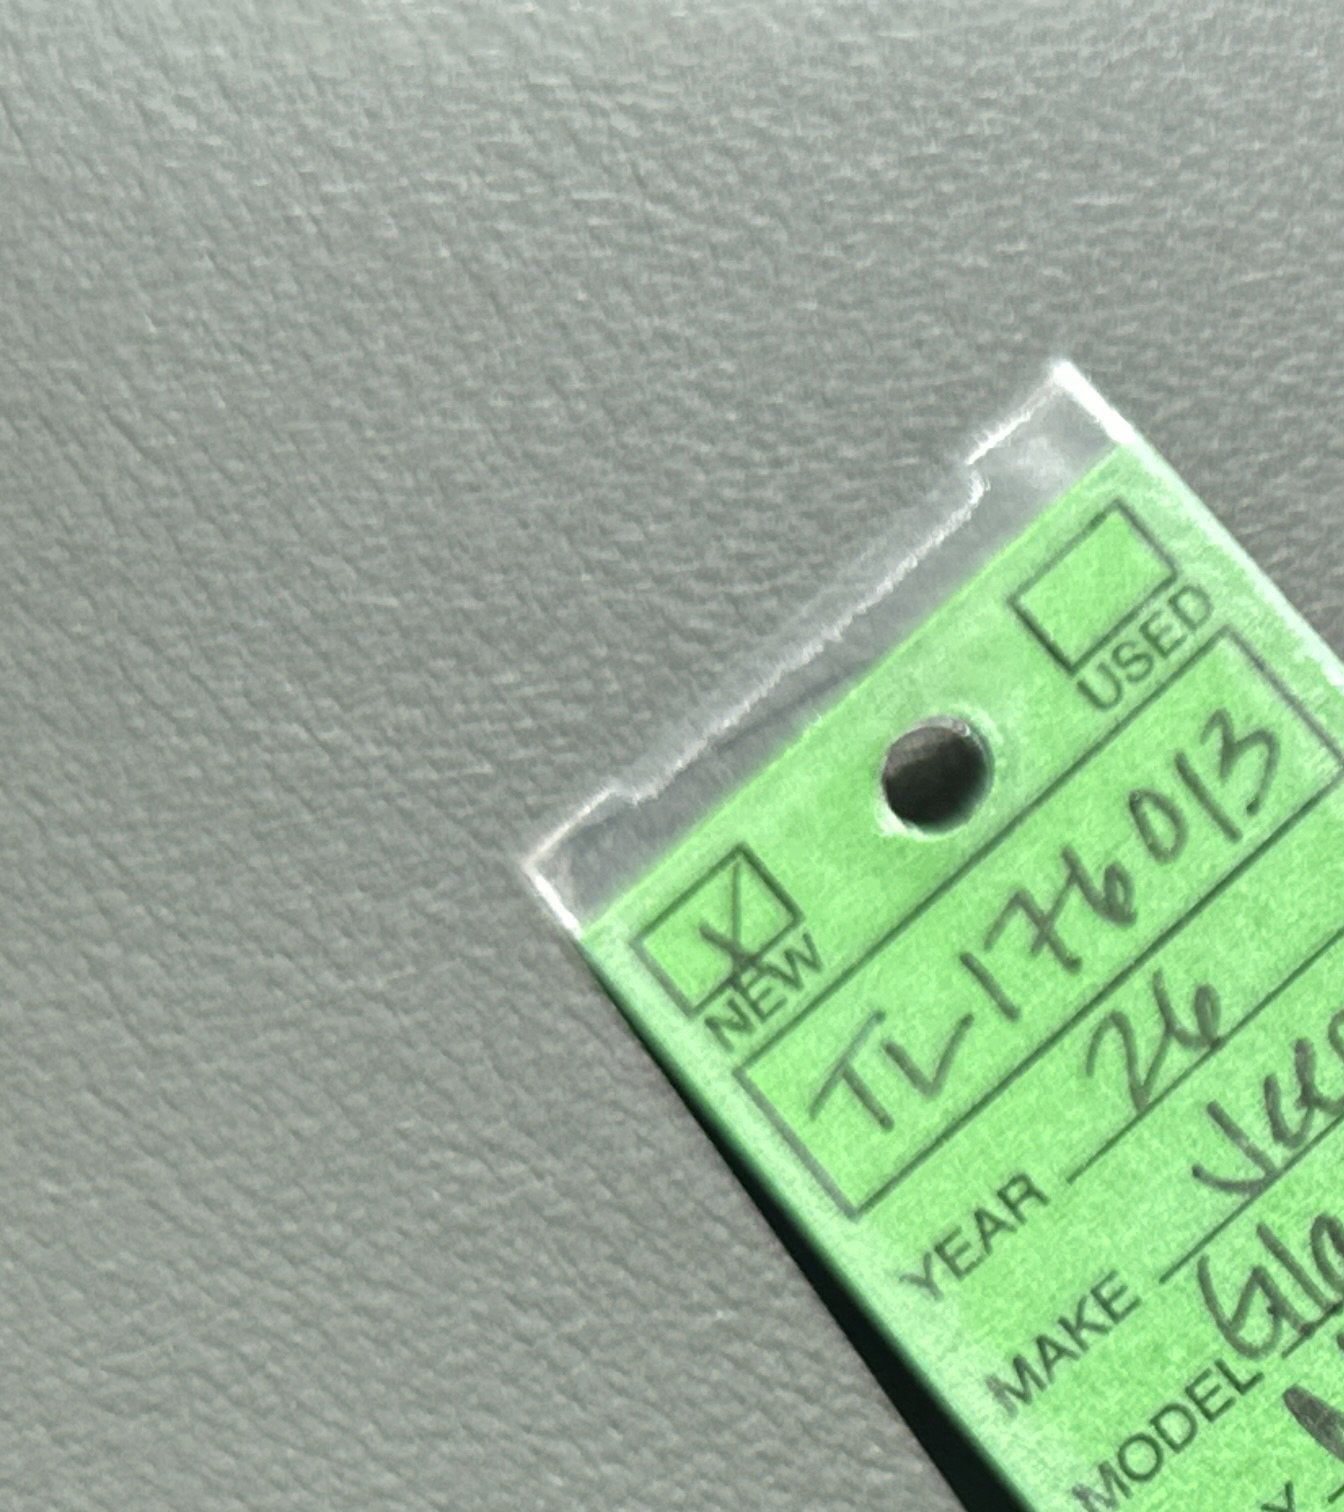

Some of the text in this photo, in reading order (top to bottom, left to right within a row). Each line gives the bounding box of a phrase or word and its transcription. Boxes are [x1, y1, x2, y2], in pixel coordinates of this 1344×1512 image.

[1075, 584, 1214, 713] USED
[704, 934, 824, 1050] NEW
[1086, 971, 1223, 1112] 26
[901, 1173, 1051, 1302] YEAR
[989, 1271, 1141, 1417] MAKE
